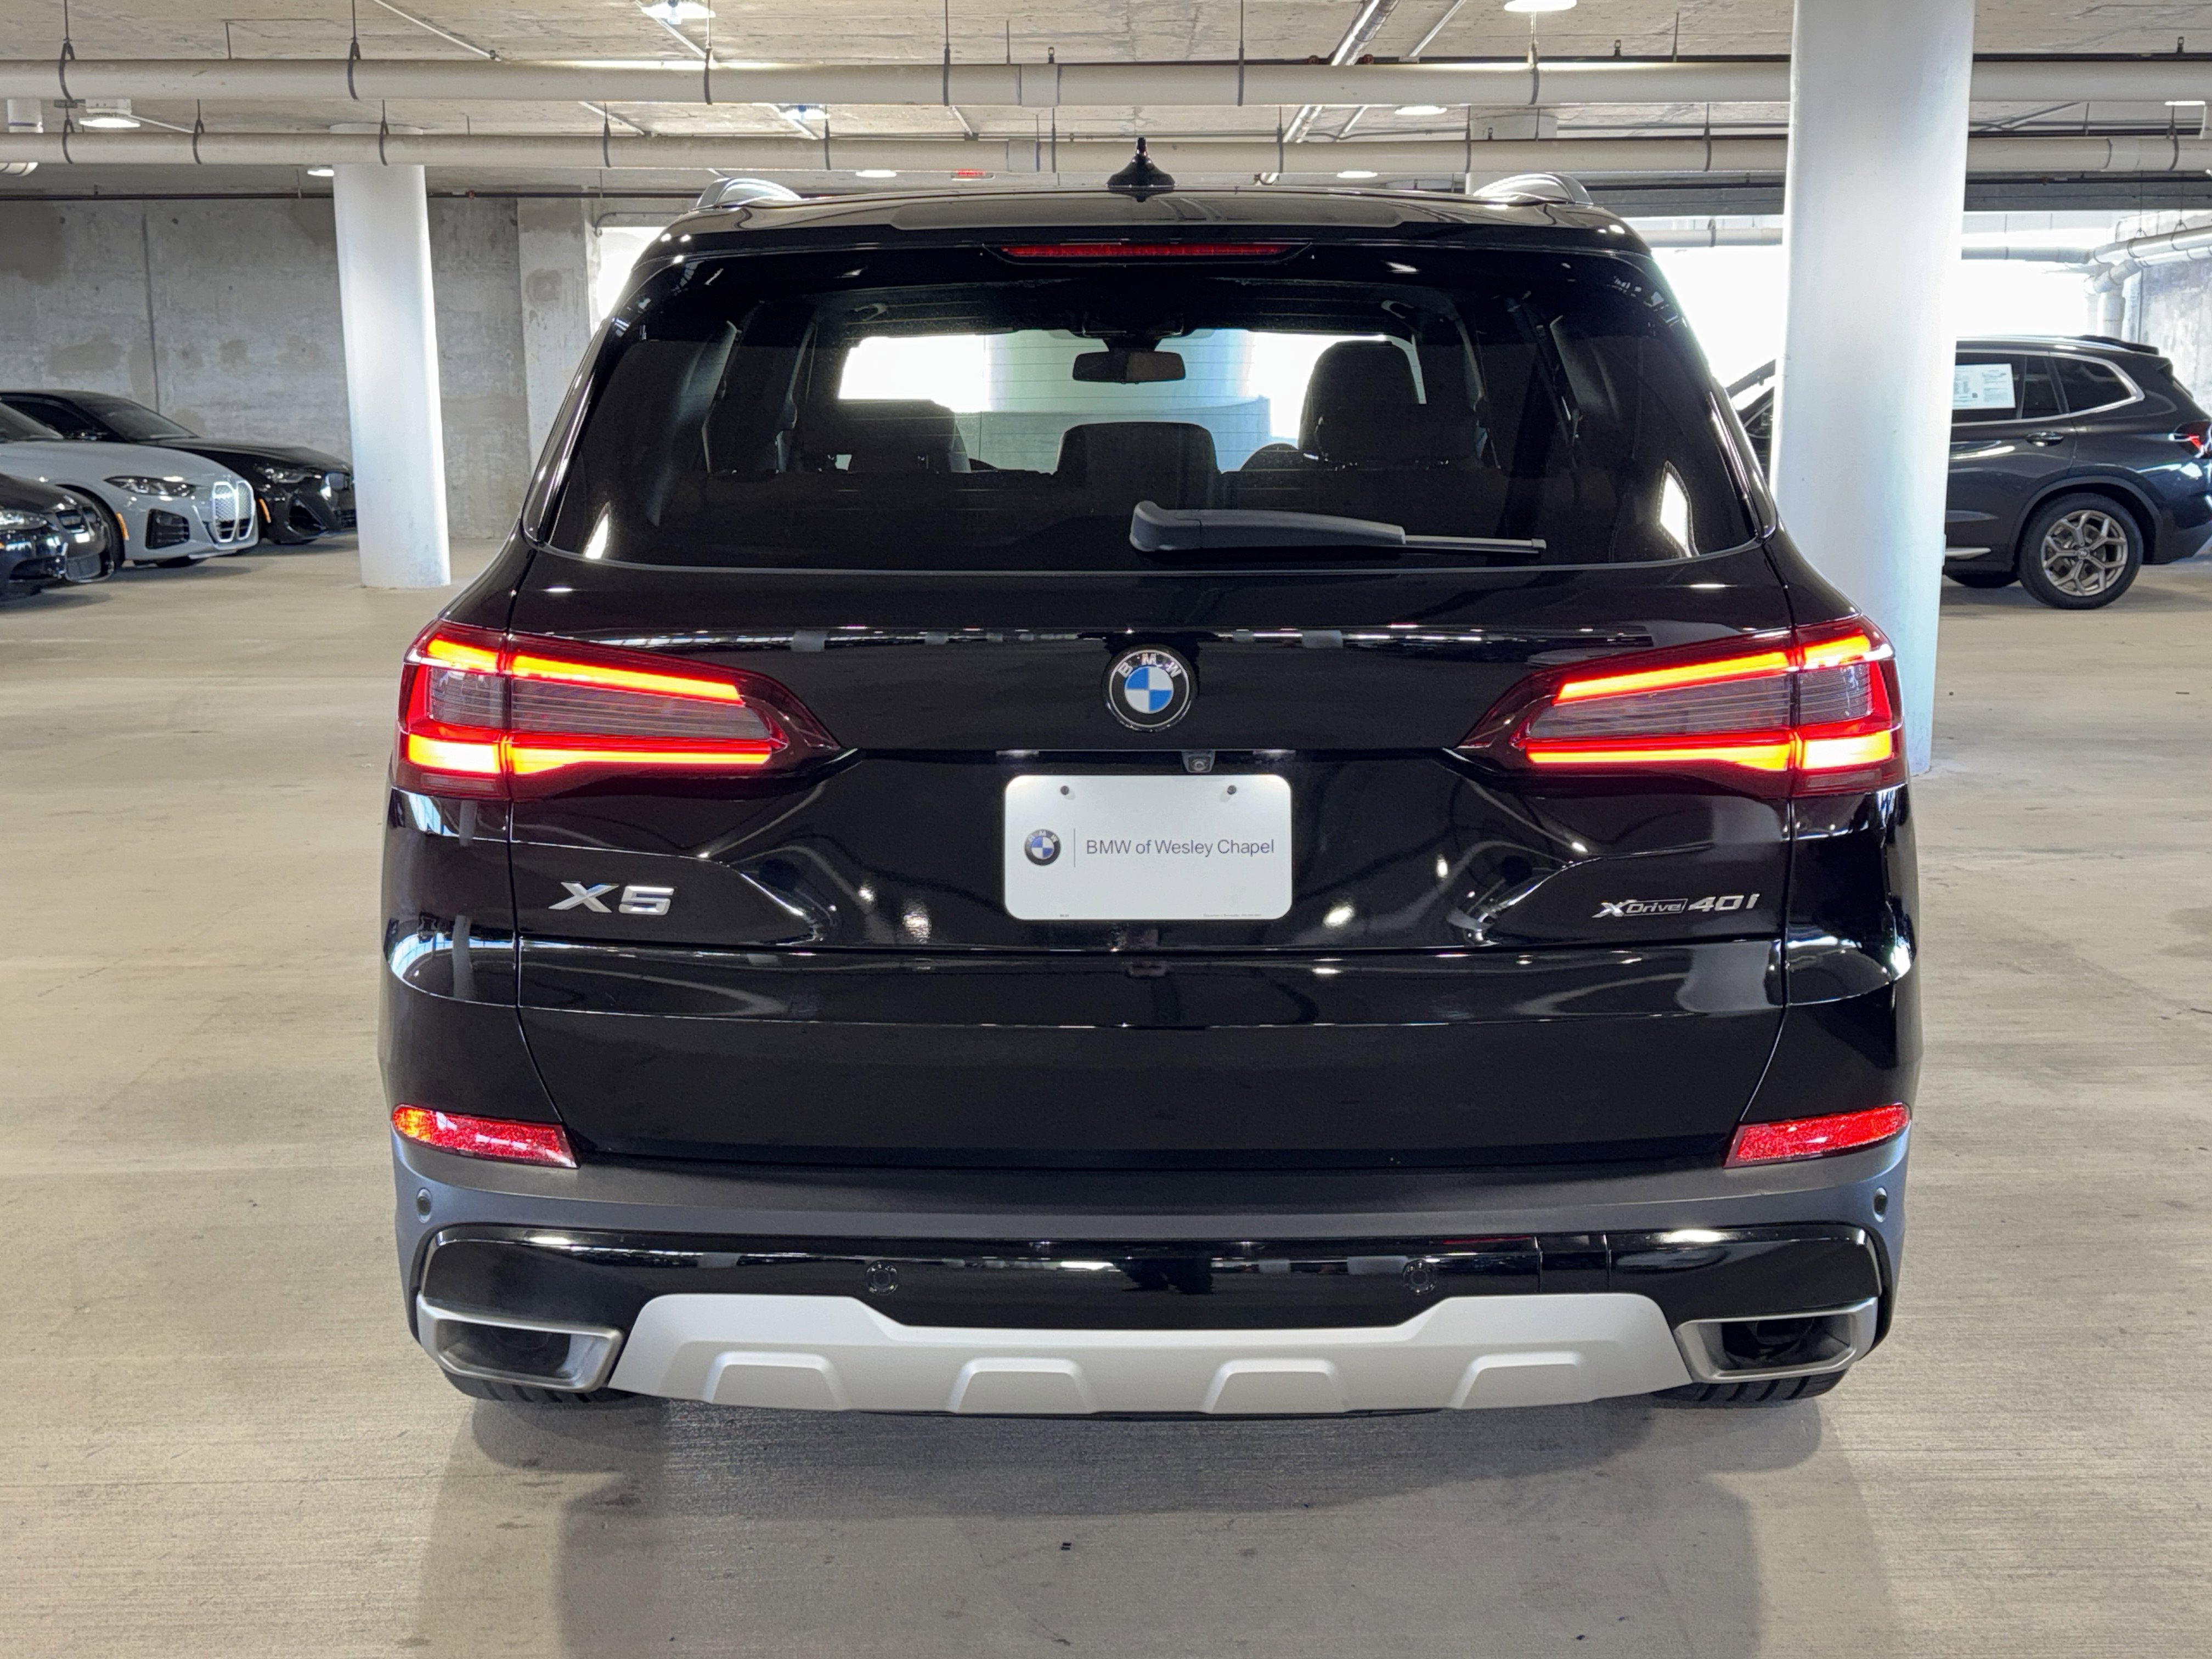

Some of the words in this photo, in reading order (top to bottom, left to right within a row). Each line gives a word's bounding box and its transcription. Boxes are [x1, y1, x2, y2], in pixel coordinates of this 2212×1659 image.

[1118, 653, 1182, 678] BMW
[1086, 839, 1132, 854] BMW
[1136, 839, 1152, 854] of
[1154, 839, 1214, 857] Wesley
[1217, 839, 1274, 857] Chapel
[548, 881, 675, 916] X5
